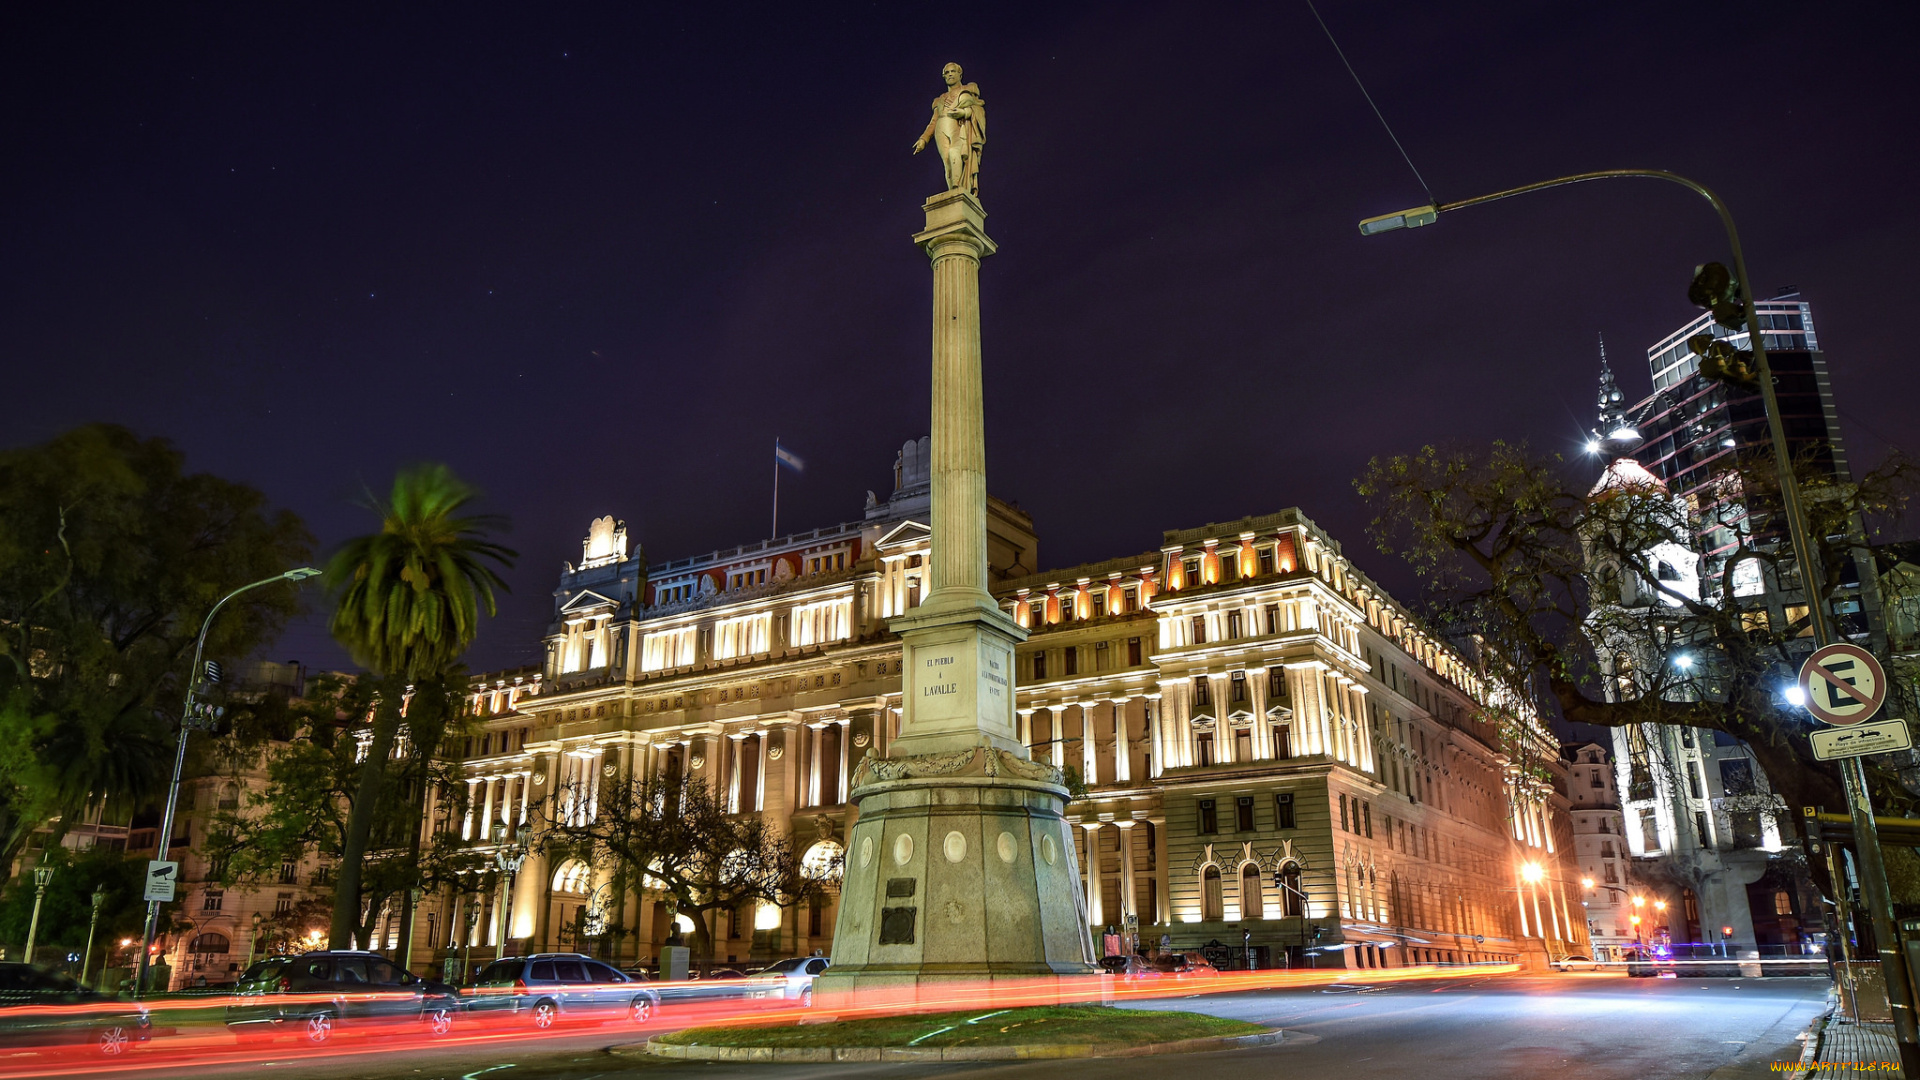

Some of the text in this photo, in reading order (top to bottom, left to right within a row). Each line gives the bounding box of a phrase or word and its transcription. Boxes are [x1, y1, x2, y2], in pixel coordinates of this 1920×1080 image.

[927, 656, 954, 667] EL PUEBLO
[924, 683, 957, 696] LAVALLE
[1823, 660, 1862, 708] E
[1806, 808, 1812, 816] P
